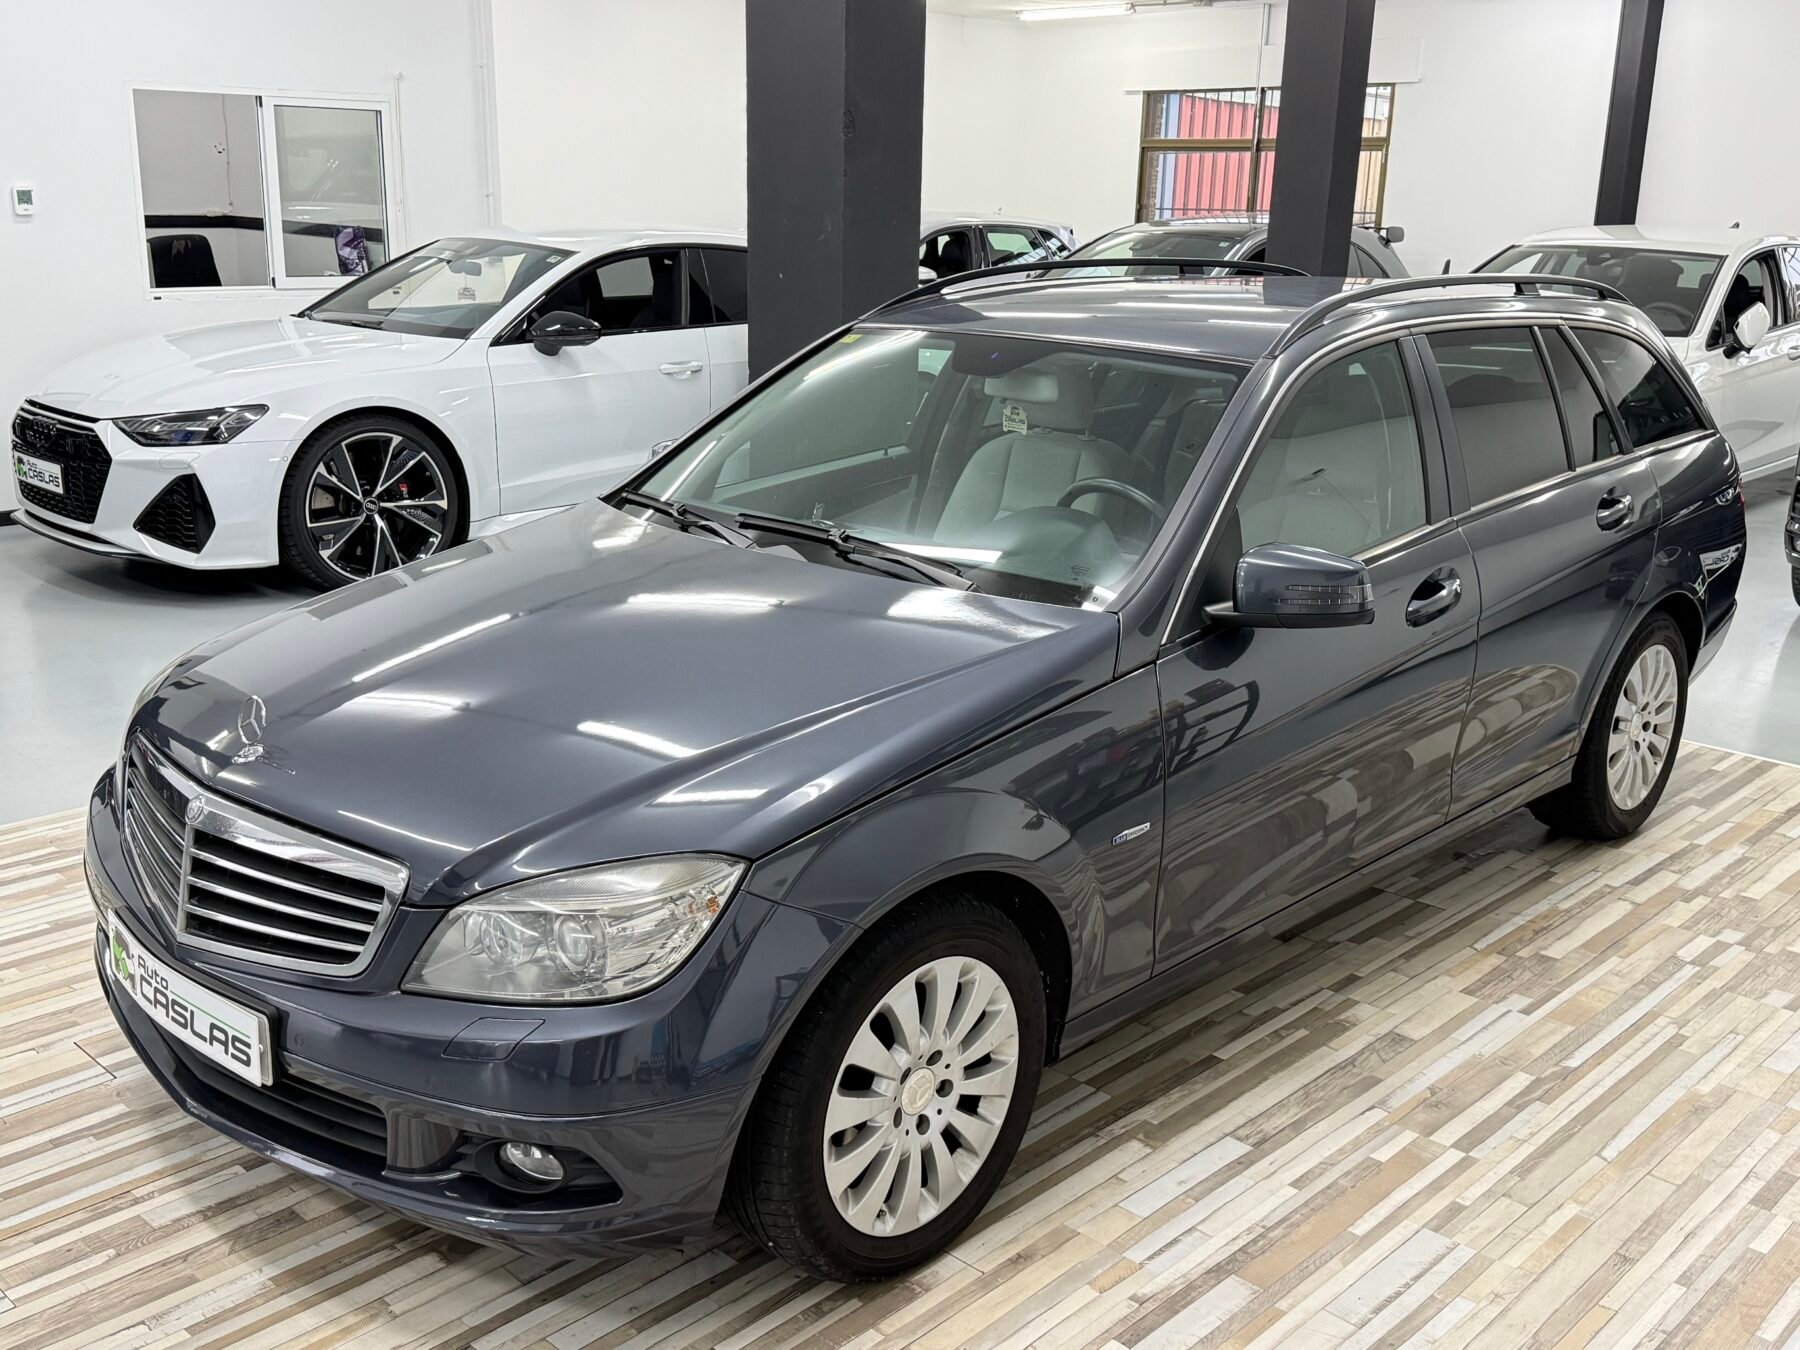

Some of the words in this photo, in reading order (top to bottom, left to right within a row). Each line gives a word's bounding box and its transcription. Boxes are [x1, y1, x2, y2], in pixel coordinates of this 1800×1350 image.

[27, 467, 60, 488] CASLAS
[137, 953, 169, 992] Auto
[139, 973, 252, 1068] CASLAS
